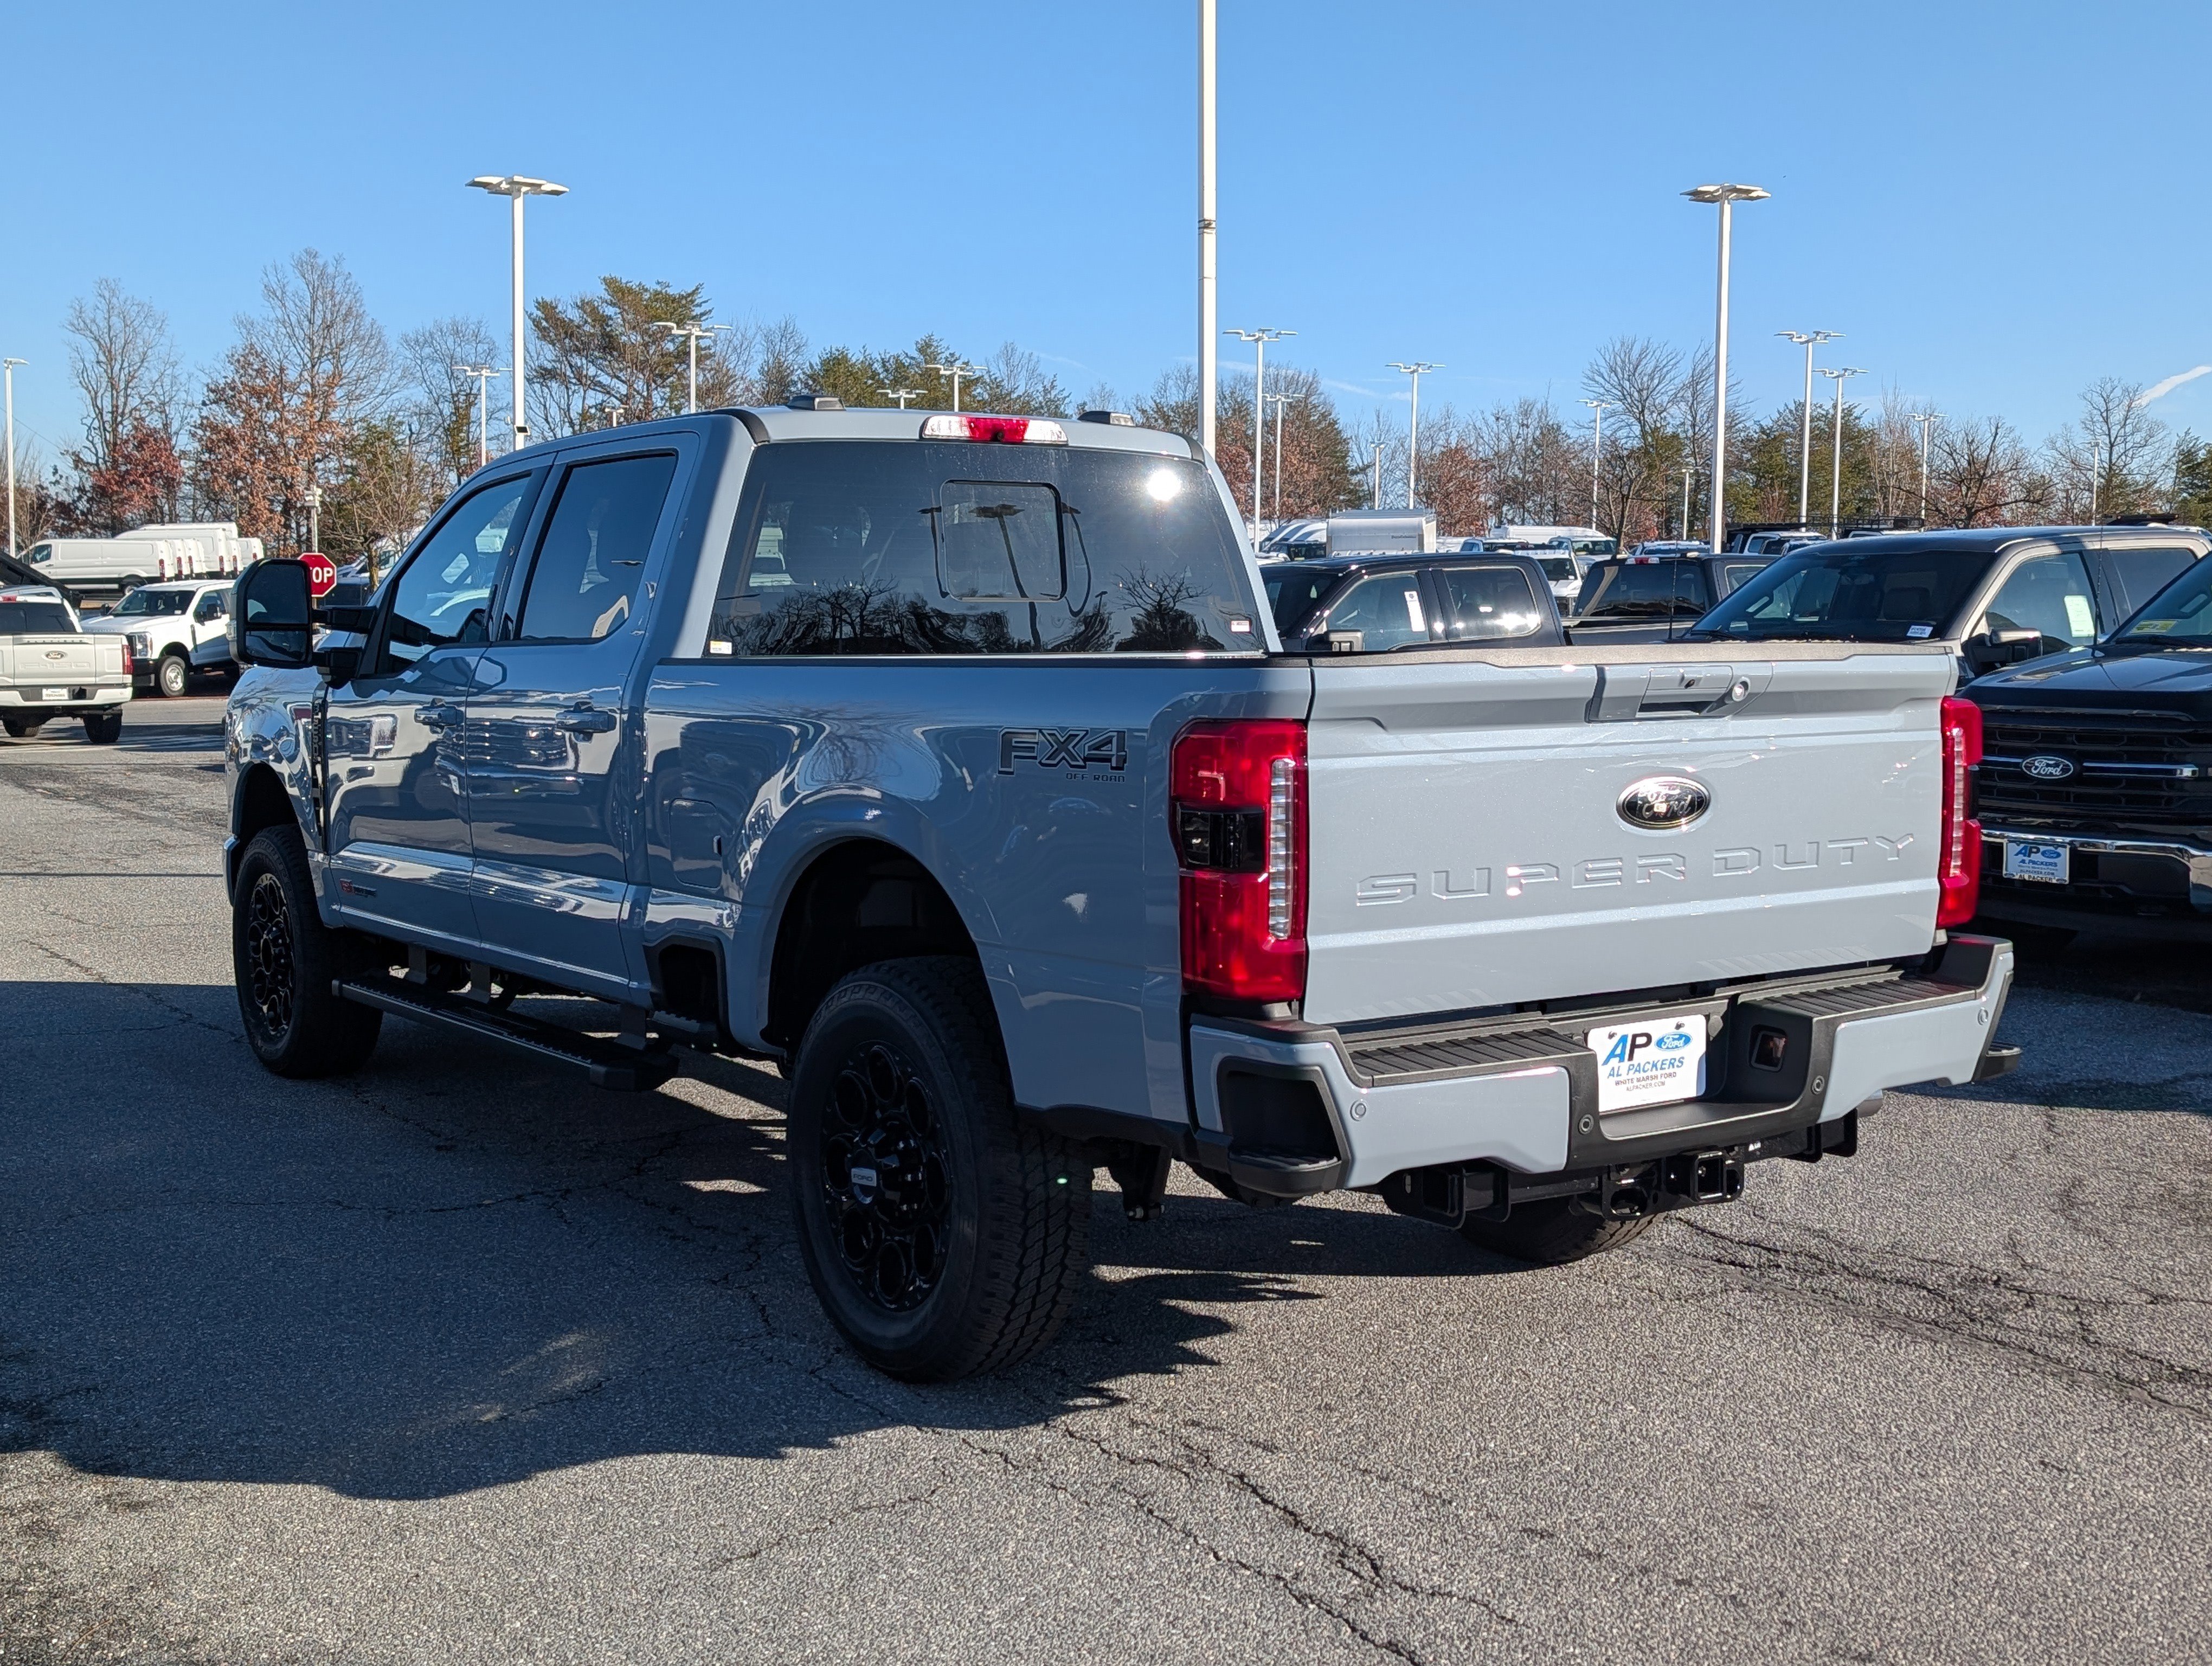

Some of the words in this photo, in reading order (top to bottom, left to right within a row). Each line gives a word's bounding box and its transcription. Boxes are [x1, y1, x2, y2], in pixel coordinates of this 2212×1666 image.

[310, 567, 333, 583] OP
[998, 727, 1128, 776] FX4
[2031, 759, 2063, 776] Ford
[1093, 774, 1125, 783] ROAD
[2014, 845, 2040, 857] AP
[1356, 853, 1686, 906] SUPER
[1713, 833, 1914, 877] DUTY
[1602, 1033, 1652, 1066] AP
[1607, 1066, 1622, 1079] AL
[1626, 1056, 1685, 1075] PACKERS
[1636, 1074, 1658, 1082] MARSH
